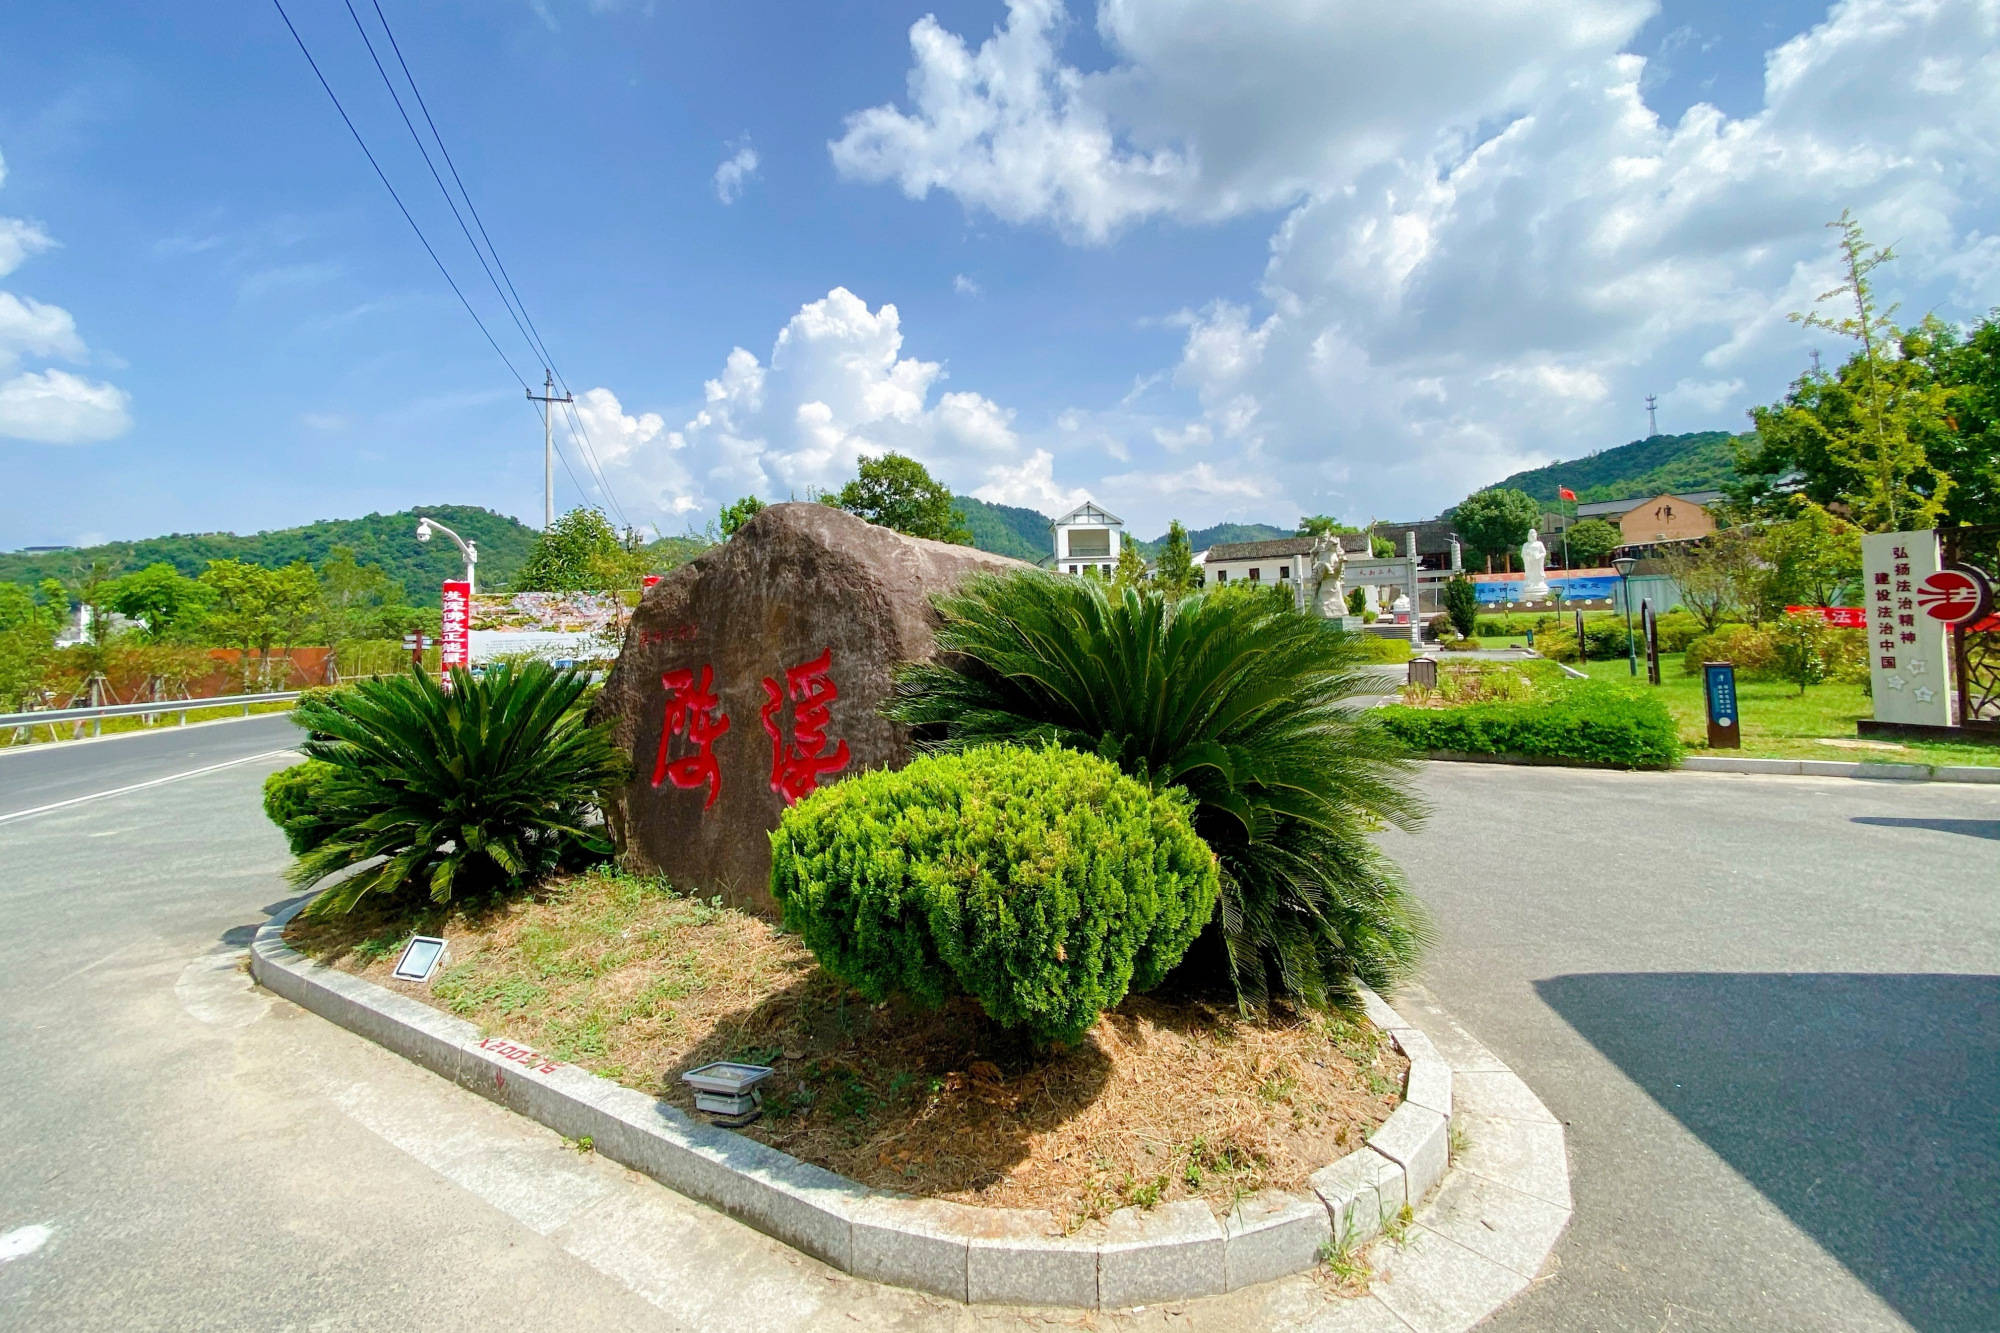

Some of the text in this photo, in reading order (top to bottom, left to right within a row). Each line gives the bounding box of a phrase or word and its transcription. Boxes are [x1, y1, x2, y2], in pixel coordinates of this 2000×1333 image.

[1874, 572, 1896, 669] 建设法治中国
[1892, 546, 1916, 645] 弘扬法治精神
